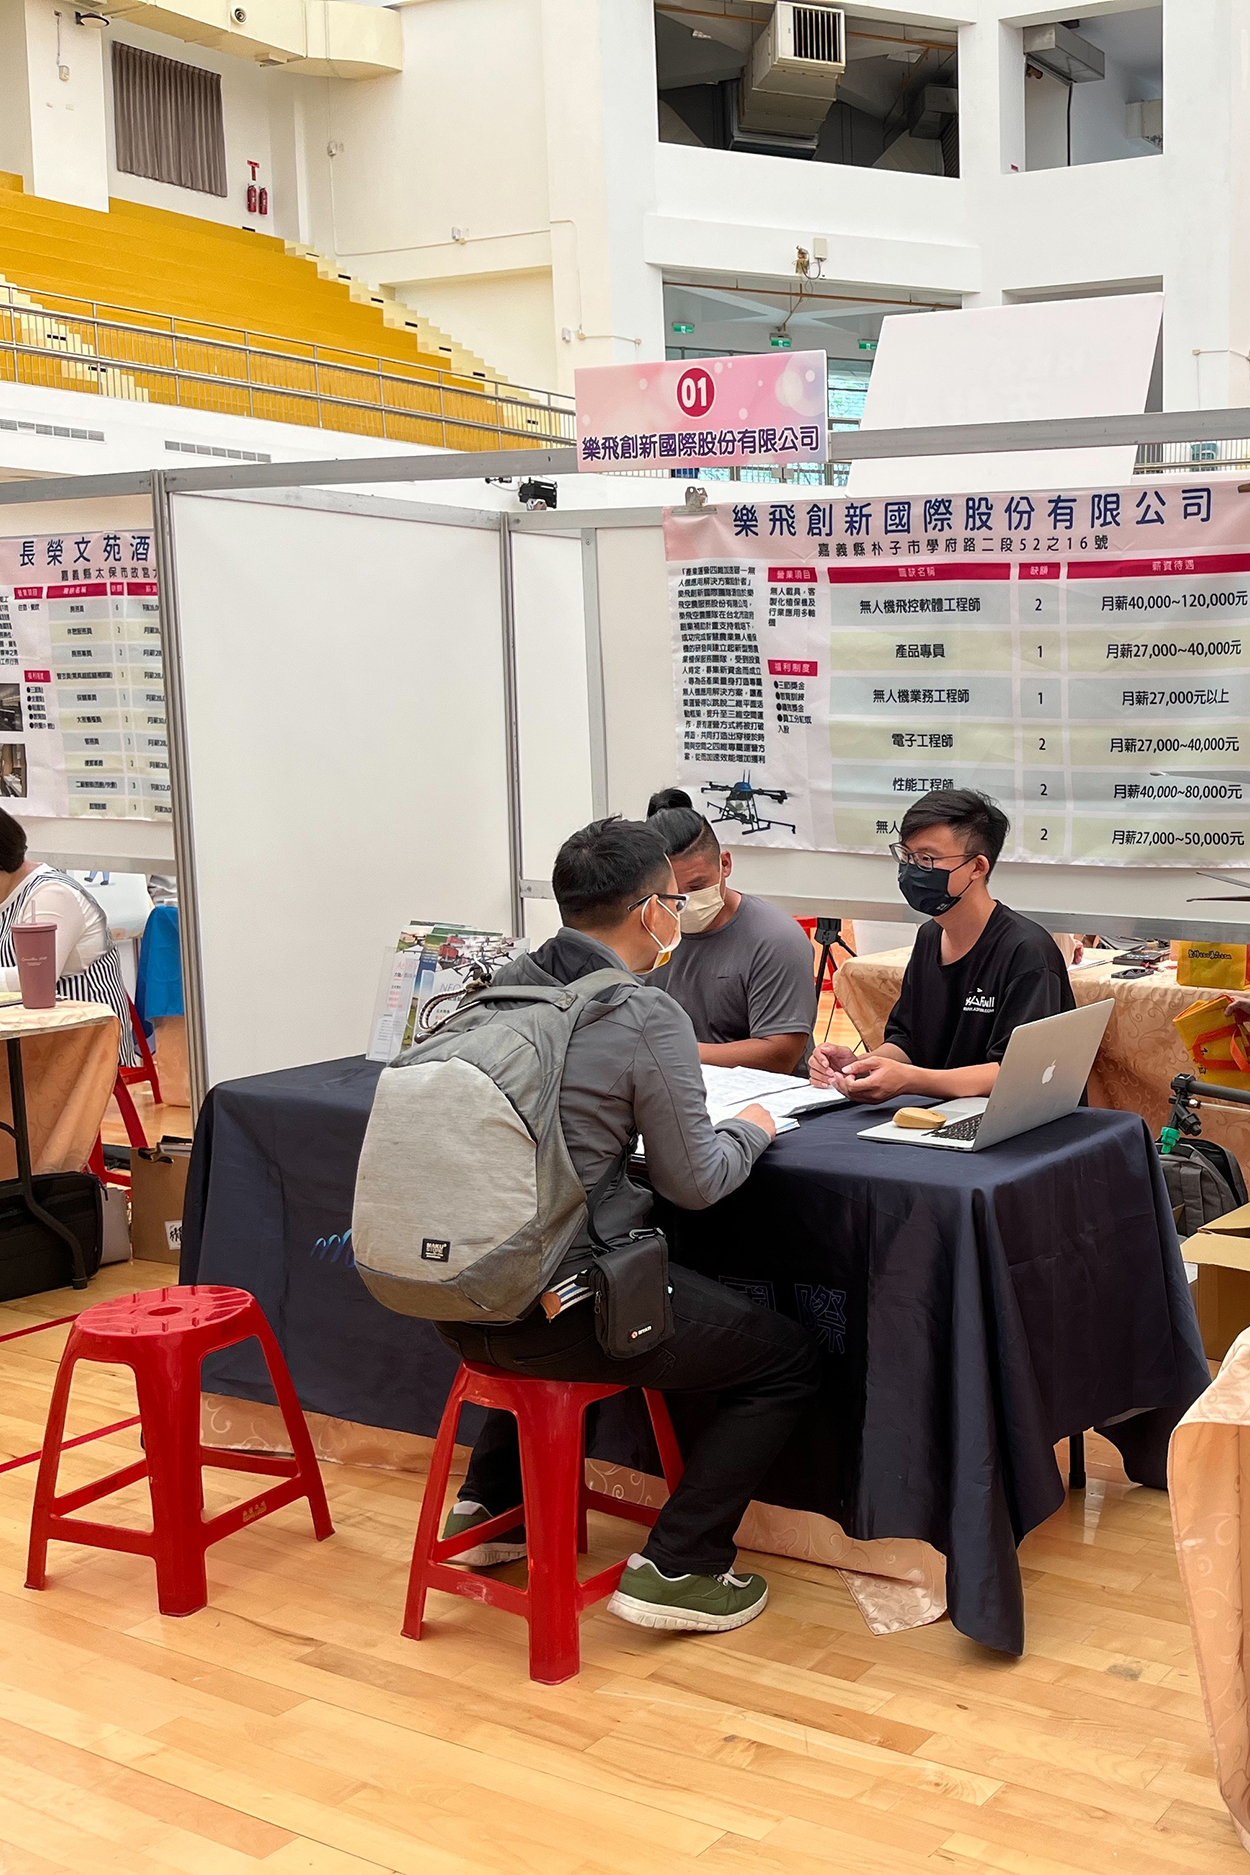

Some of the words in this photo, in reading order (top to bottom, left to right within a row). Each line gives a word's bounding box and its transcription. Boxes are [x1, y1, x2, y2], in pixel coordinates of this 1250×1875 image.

[681, 377, 707, 408] 01
[581, 425, 820, 461] 樂飛創新國際股份有限公司
[733, 488, 1215, 540] 樂飛創新國際股份有限公司
[19, 534, 151, 567] 長榮文苑酒
[818, 533, 1110, 558] 嘉義縣朴子市學府路二段52之16號
[898, 567, 936, 578] 職缺名稱
[1030, 565, 1048, 575] 缺額
[1152, 560, 1195, 572] 薪資待遇
[776, 570, 811, 580] 營業項目
[769, 597, 816, 607] 製化植保機及
[859, 597, 981, 615] 無人機飛控軟體工程師
[1034, 598, 1043, 612] 2
[1101, 590, 1248, 612] 月薪40,000~120,000元
[769, 608, 816, 618] 行業應用多軸
[768, 618, 776, 627] 機
[895, 642, 946, 660] 產品專員
[1037, 645, 1044, 658] 1
[1106, 639, 1242, 660] 月薪27,000~40,000元
[774, 662, 811, 674] 福利制度
[872, 688, 970, 705] 無人機業務工程師
[1037, 691, 1044, 705] 1
[1122, 688, 1230, 706] 月薪27,000元以上
[891, 733, 954, 749] 電子工程師
[1038, 738, 1046, 751] 2
[1110, 736, 1240, 754] 月薪27,000~40,000元
[1040, 784, 1048, 797] 2
[1113, 783, 1243, 801] 月薪40,000~80,000元
[1040, 828, 1048, 842] 2
[1112, 829, 1245, 849] 月薪27,000~50,000元
